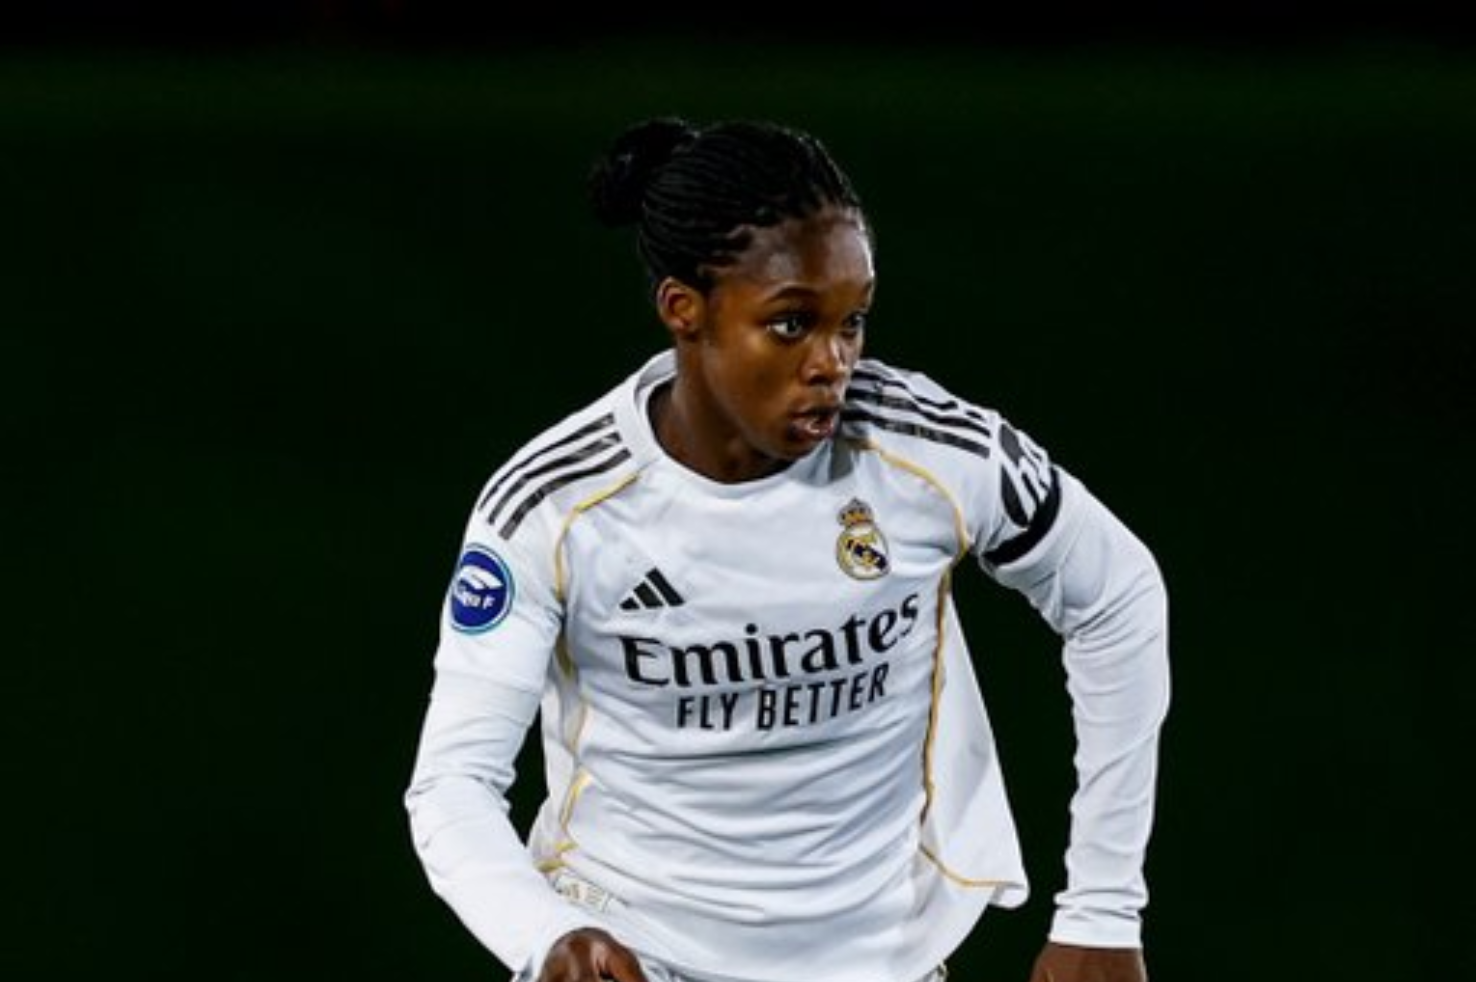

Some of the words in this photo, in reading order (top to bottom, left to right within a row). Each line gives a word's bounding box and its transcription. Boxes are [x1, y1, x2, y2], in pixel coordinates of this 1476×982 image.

[620, 594, 919, 687] Emirates
[677, 693, 739, 731] FLY
[757, 662, 889, 730] BETTER
